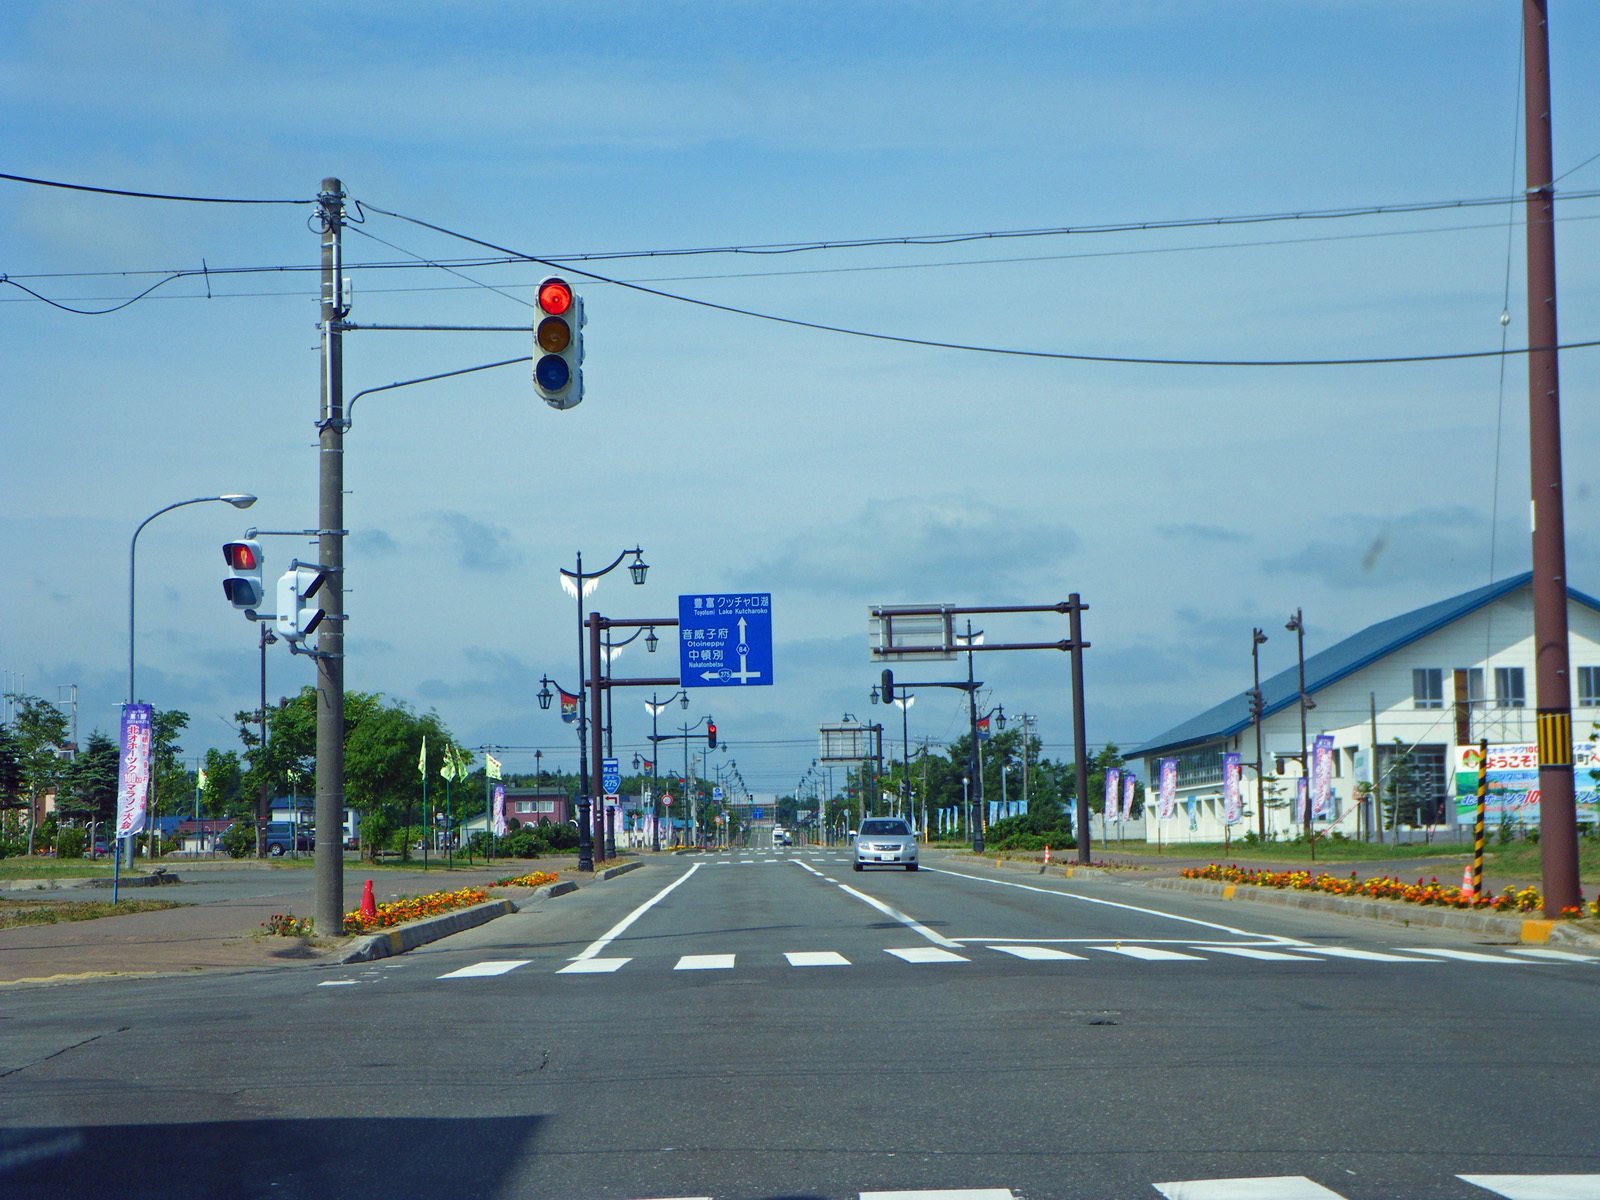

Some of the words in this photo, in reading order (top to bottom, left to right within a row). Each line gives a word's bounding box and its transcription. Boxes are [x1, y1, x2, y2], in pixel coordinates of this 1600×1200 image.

[694, 597, 715, 608] 豊富
[682, 628, 729, 640] 音威子府
[688, 650, 724, 660] 中頓別
